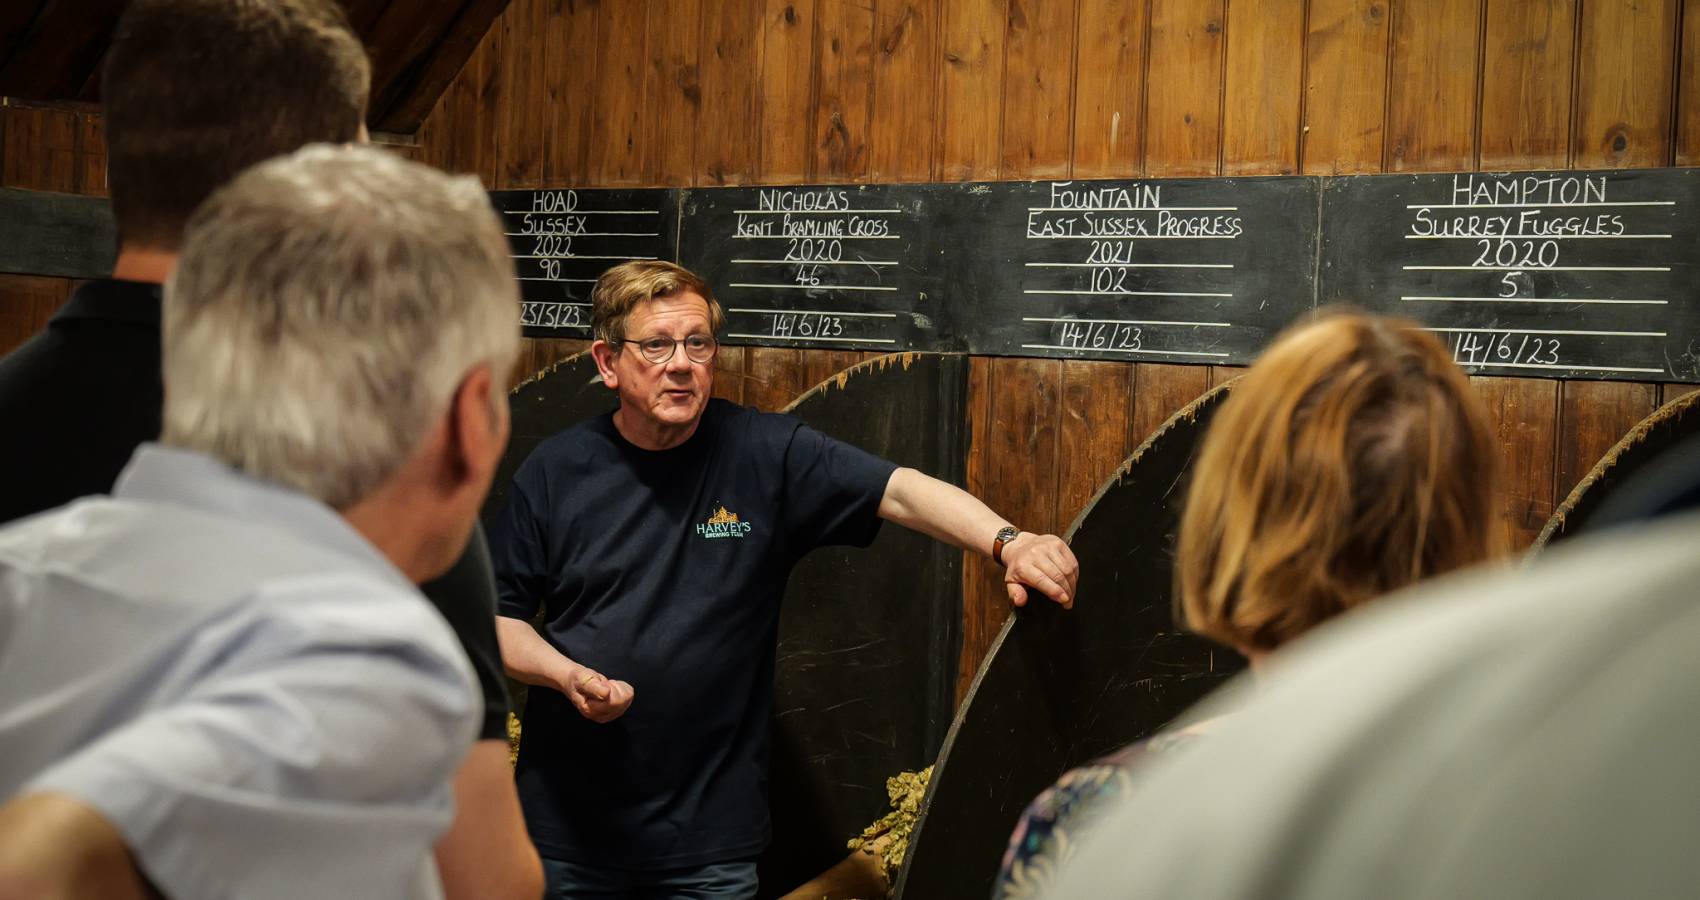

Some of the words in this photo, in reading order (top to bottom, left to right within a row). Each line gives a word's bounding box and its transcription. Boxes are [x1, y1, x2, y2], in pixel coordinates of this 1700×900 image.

[532, 189, 578, 213] HOAD
[759, 189, 849, 212] NICHOLAS
[1453, 174, 1607, 206] HAMPTON
[737, 214, 774, 237] KENT
[782, 213, 845, 239] BRAMLING
[848, 215, 889, 237] CROSS
[1027, 210, 1078, 238] EAST
[1080, 212, 1150, 237] SUSSEX
[1157, 210, 1243, 238] PROGRESS
[1411, 208, 1512, 243] SURREY
[1518, 210, 1625, 238] FUGGLES
[532, 235, 575, 257] 2022
[784, 238, 842, 262] 2020
[1086, 240, 1134, 264] 2021
[1472, 239, 1560, 268] 2020
[539, 258, 561, 280] 90
[795, 264, 820, 287] 46
[1090, 267, 1132, 293] 102
[1499, 271, 1523, 298] 5
[520, 303, 580, 328] 25/5/23
[772, 313, 843, 338] 14/6/23
[1060, 322, 1143, 350] 14/6/23
[1453, 332, 1561, 370] 14/6/23
[696, 522, 751, 534] HARVEY'S
